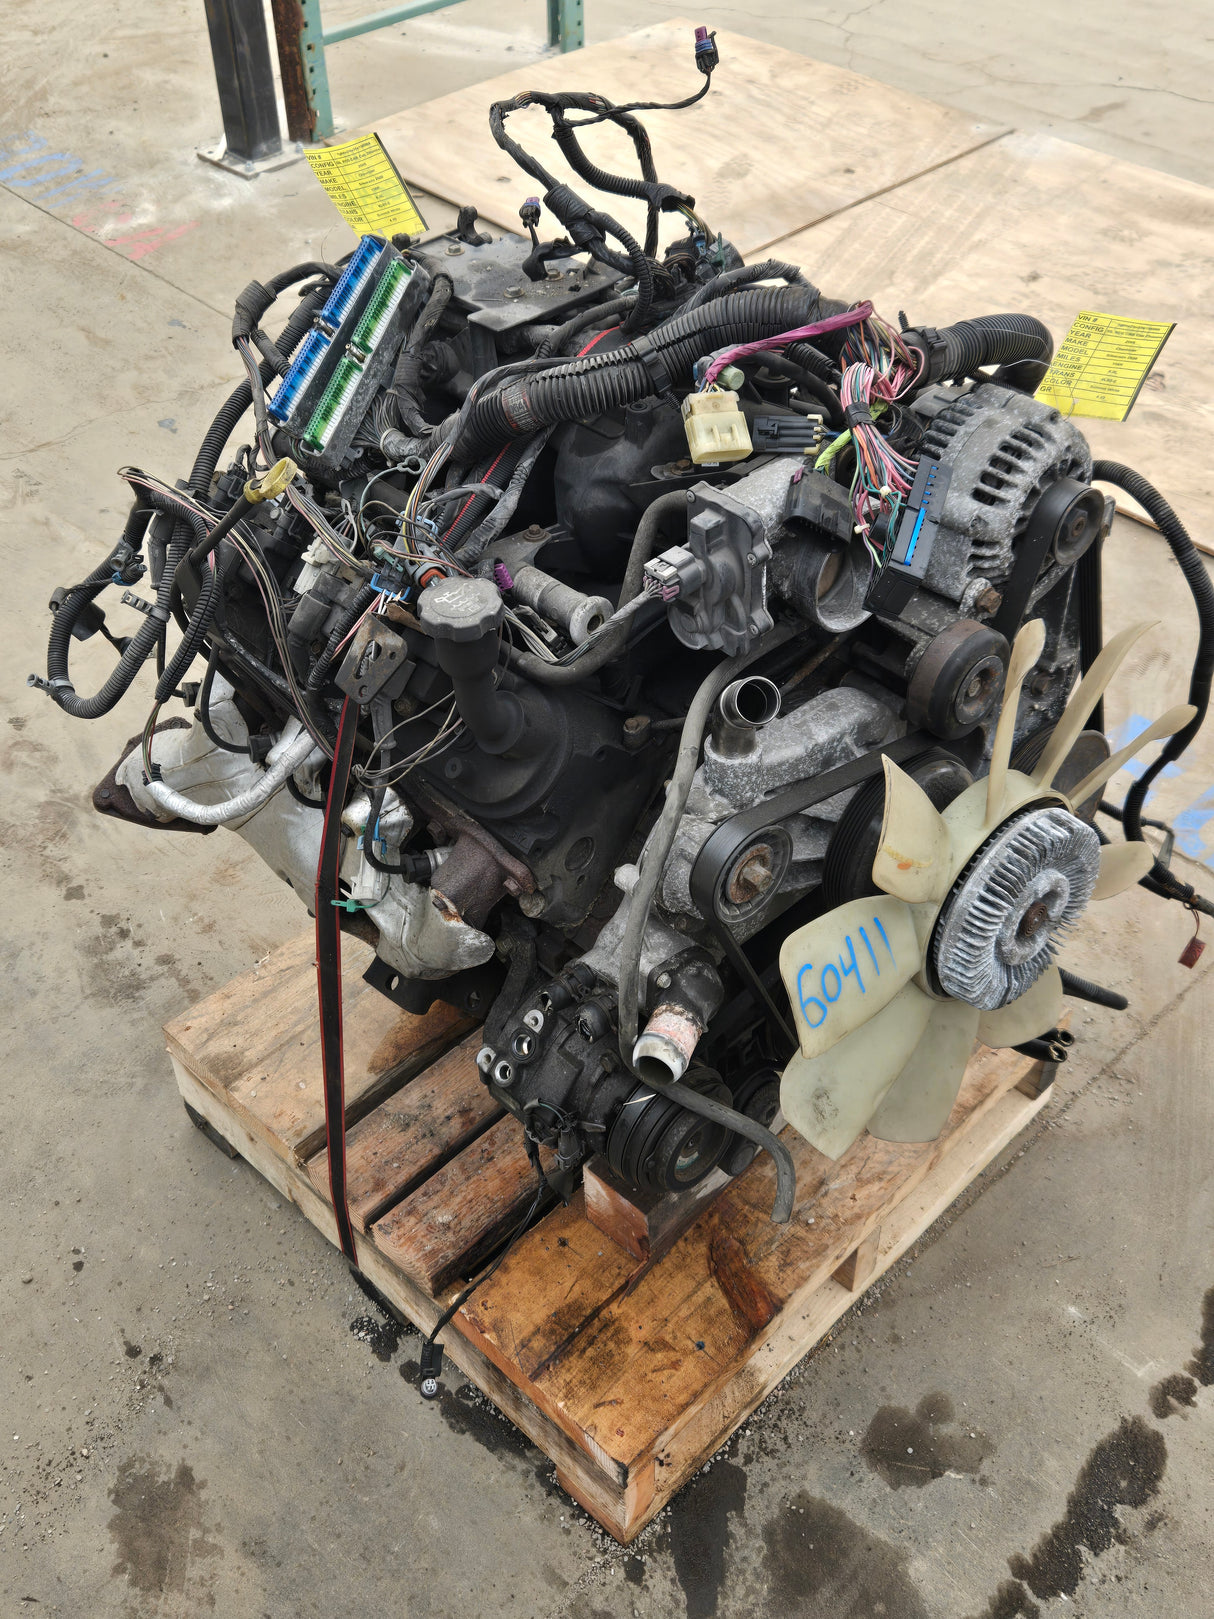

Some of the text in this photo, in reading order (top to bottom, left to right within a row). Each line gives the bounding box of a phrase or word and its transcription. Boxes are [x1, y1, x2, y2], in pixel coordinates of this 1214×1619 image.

[1078, 314, 1091, 322] VIN
[1073, 322, 1105, 333] CONFIG
[1070, 329, 1092, 339] YEAR
[1065, 337, 1089, 347] MAKE
[1061, 345, 1088, 355] MODEL
[1056, 353, 1081, 362] MILES
[1052, 361, 1083, 371] ENGINE
[1049, 369, 1076, 378] TRANS
[1044, 377, 1073, 387] COLOR
[1040, 385, 1052, 393] GR
[797, 917, 897, 1029] 60411
